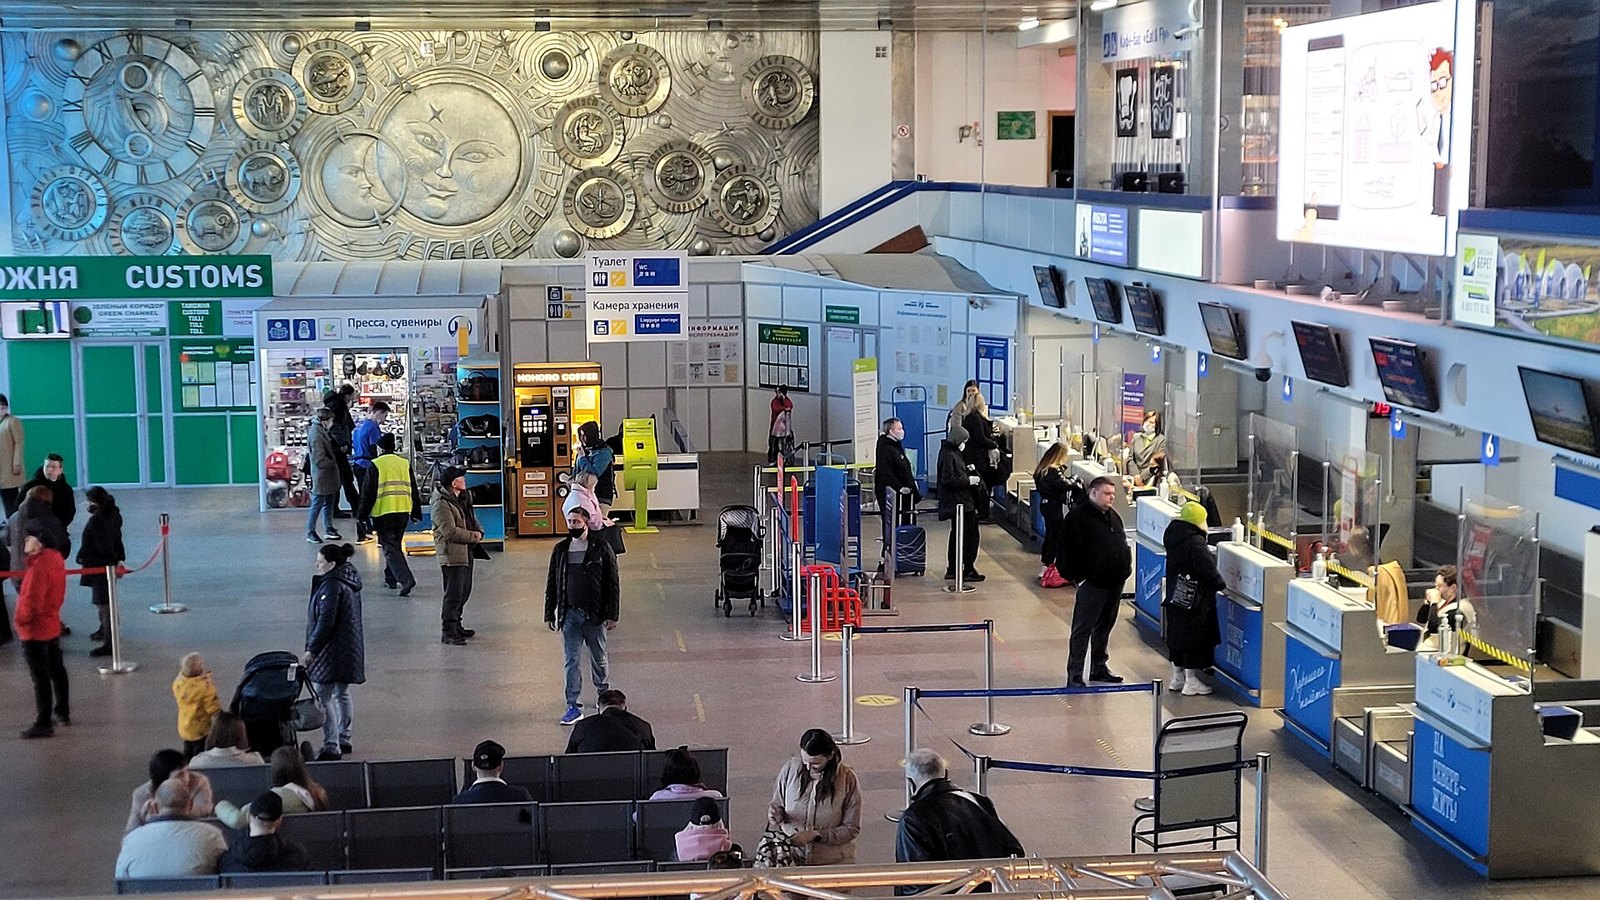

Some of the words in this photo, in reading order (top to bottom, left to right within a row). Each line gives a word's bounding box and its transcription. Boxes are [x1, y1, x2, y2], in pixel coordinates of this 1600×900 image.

[593, 257, 627, 268] Туалет
[126, 264, 263, 289] CUSTOMS
[593, 301, 630, 312] Камера
[632, 302, 679, 312] хранения
[347, 318, 388, 329] Пресса,
[391, 319, 442, 329] сувениры
[1200, 354, 1206, 372] 3
[561, 372, 598, 382] COFFEE
[1485, 434, 1495, 458] 6
[1434, 731, 1445, 758] НА
